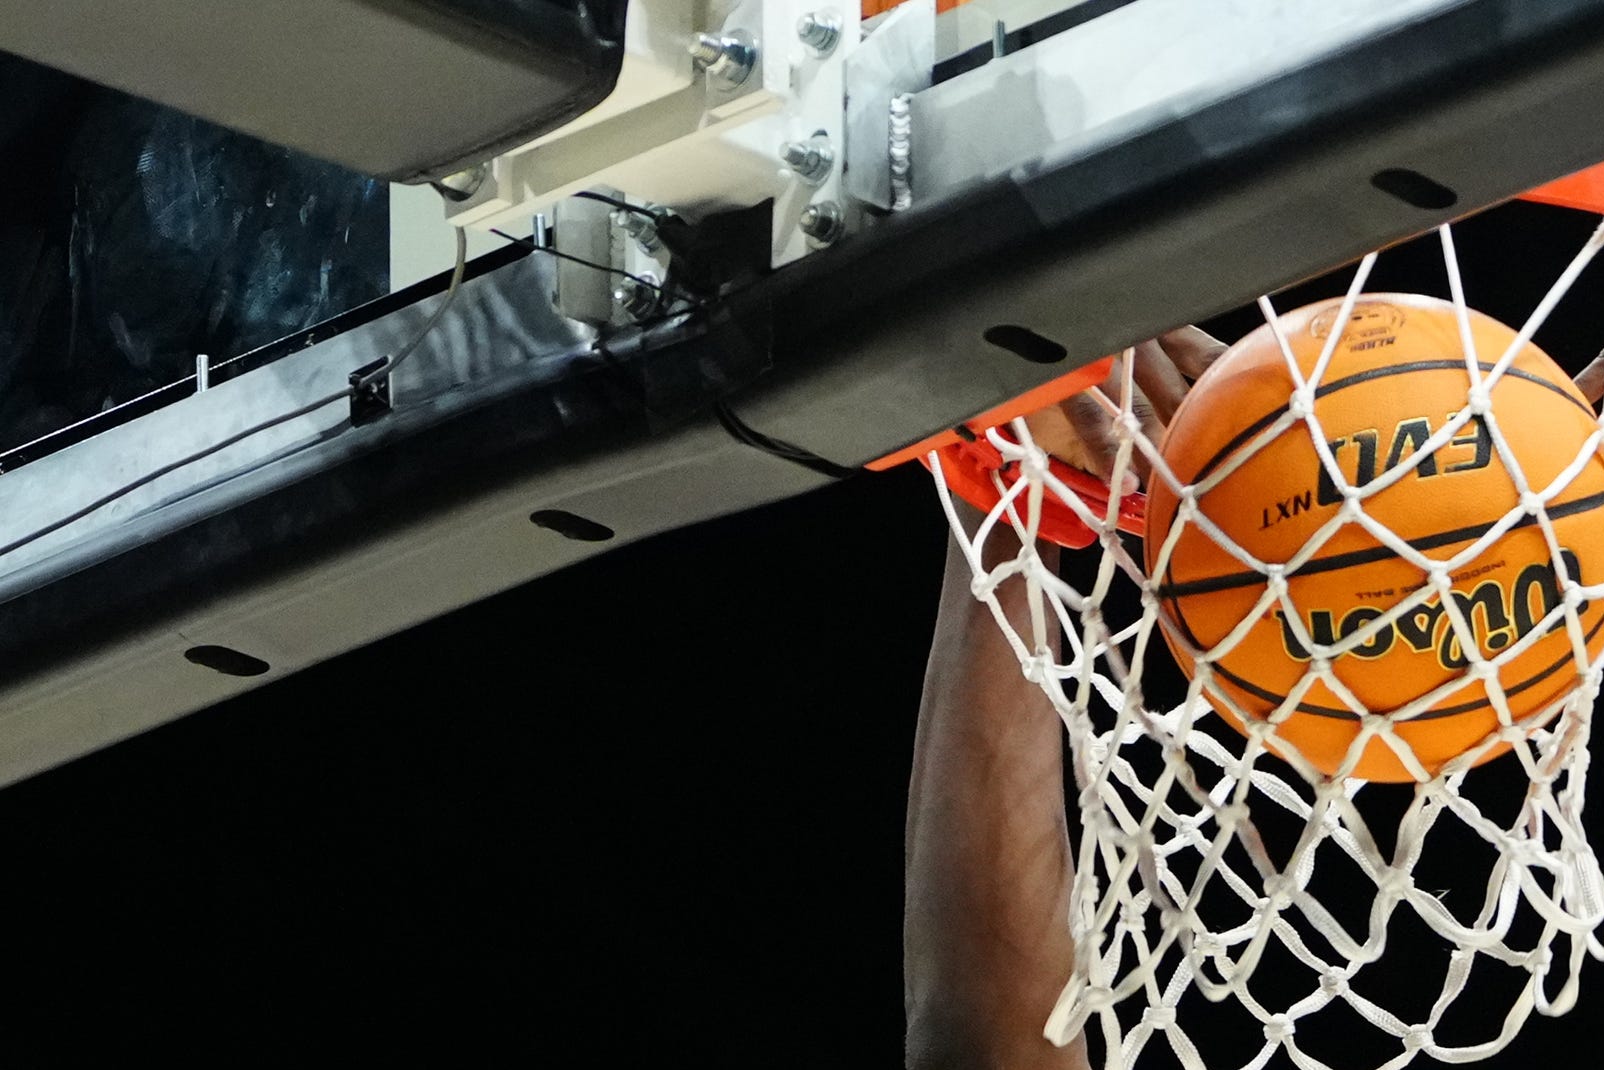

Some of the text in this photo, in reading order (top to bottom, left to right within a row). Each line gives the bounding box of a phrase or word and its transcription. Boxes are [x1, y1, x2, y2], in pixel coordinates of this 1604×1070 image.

[1258, 490, 1313, 530] NXT
[1275, 546, 1589, 671] Wilson
[1355, 588, 1396, 602] BALL
